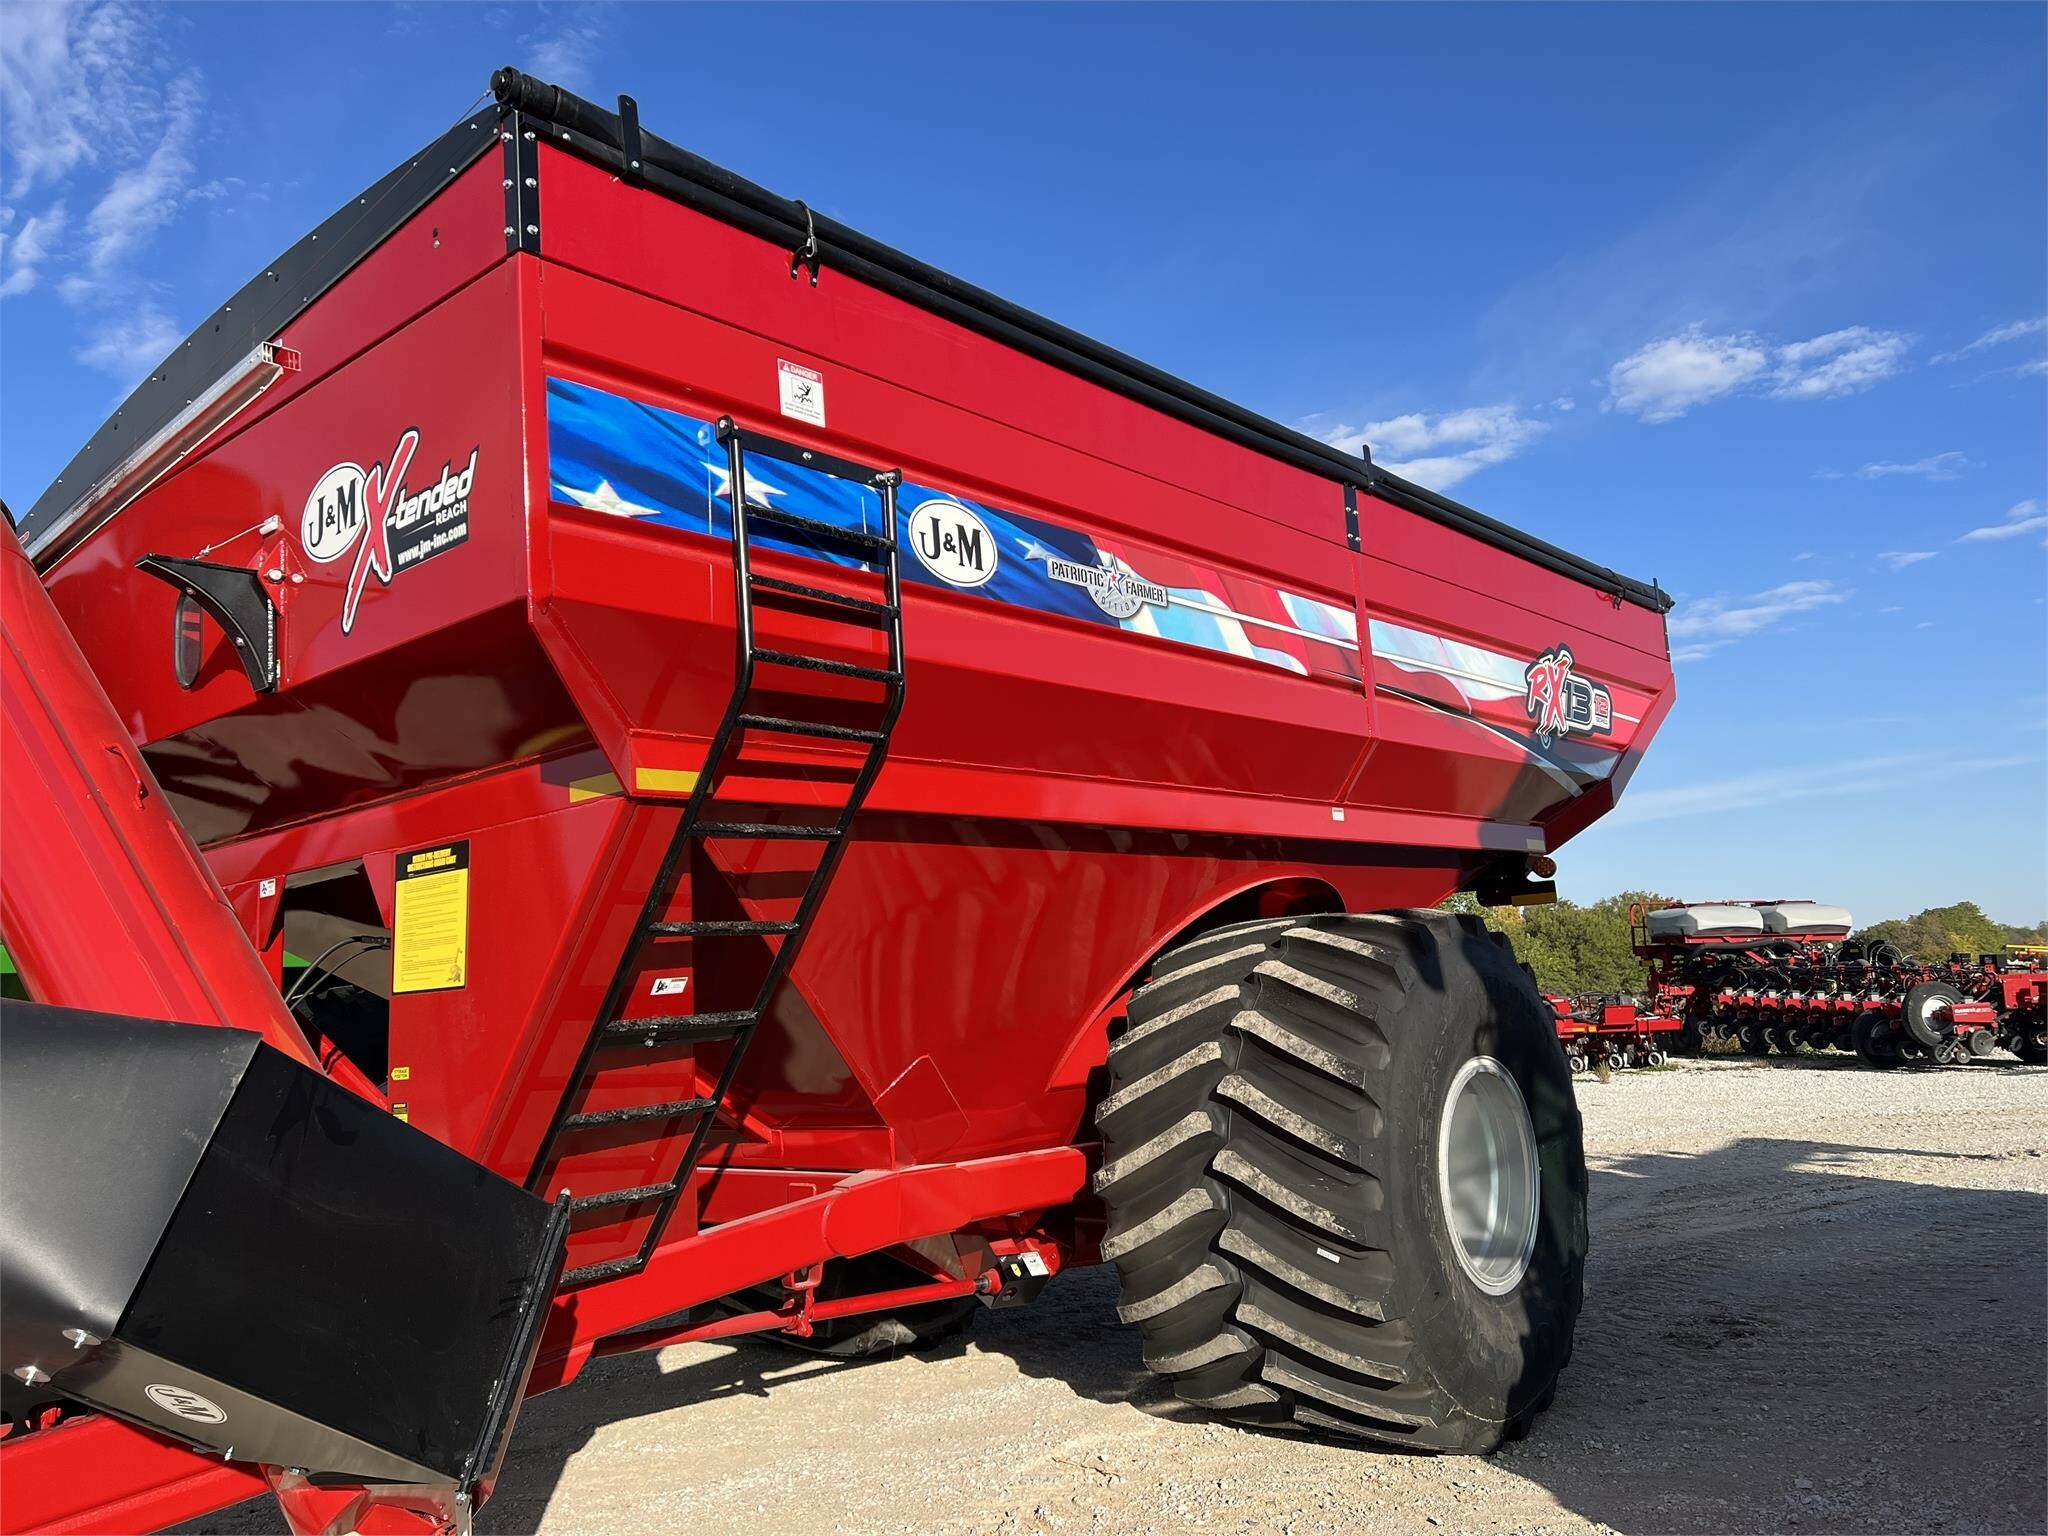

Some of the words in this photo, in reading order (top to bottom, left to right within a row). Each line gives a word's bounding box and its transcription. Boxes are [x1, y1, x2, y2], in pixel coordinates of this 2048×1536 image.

[308, 476, 359, 548] J&M
[435, 500, 468, 526] REACH
[397, 522, 468, 566] www.jm-inc.com
[918, 515, 985, 573] J&M
[1051, 560, 1105, 588] PATRIOTIC
[1125, 579, 1164, 603] FARMER
[1094, 590, 1137, 612] EDITION
[154, 1388, 218, 1420] J&M
